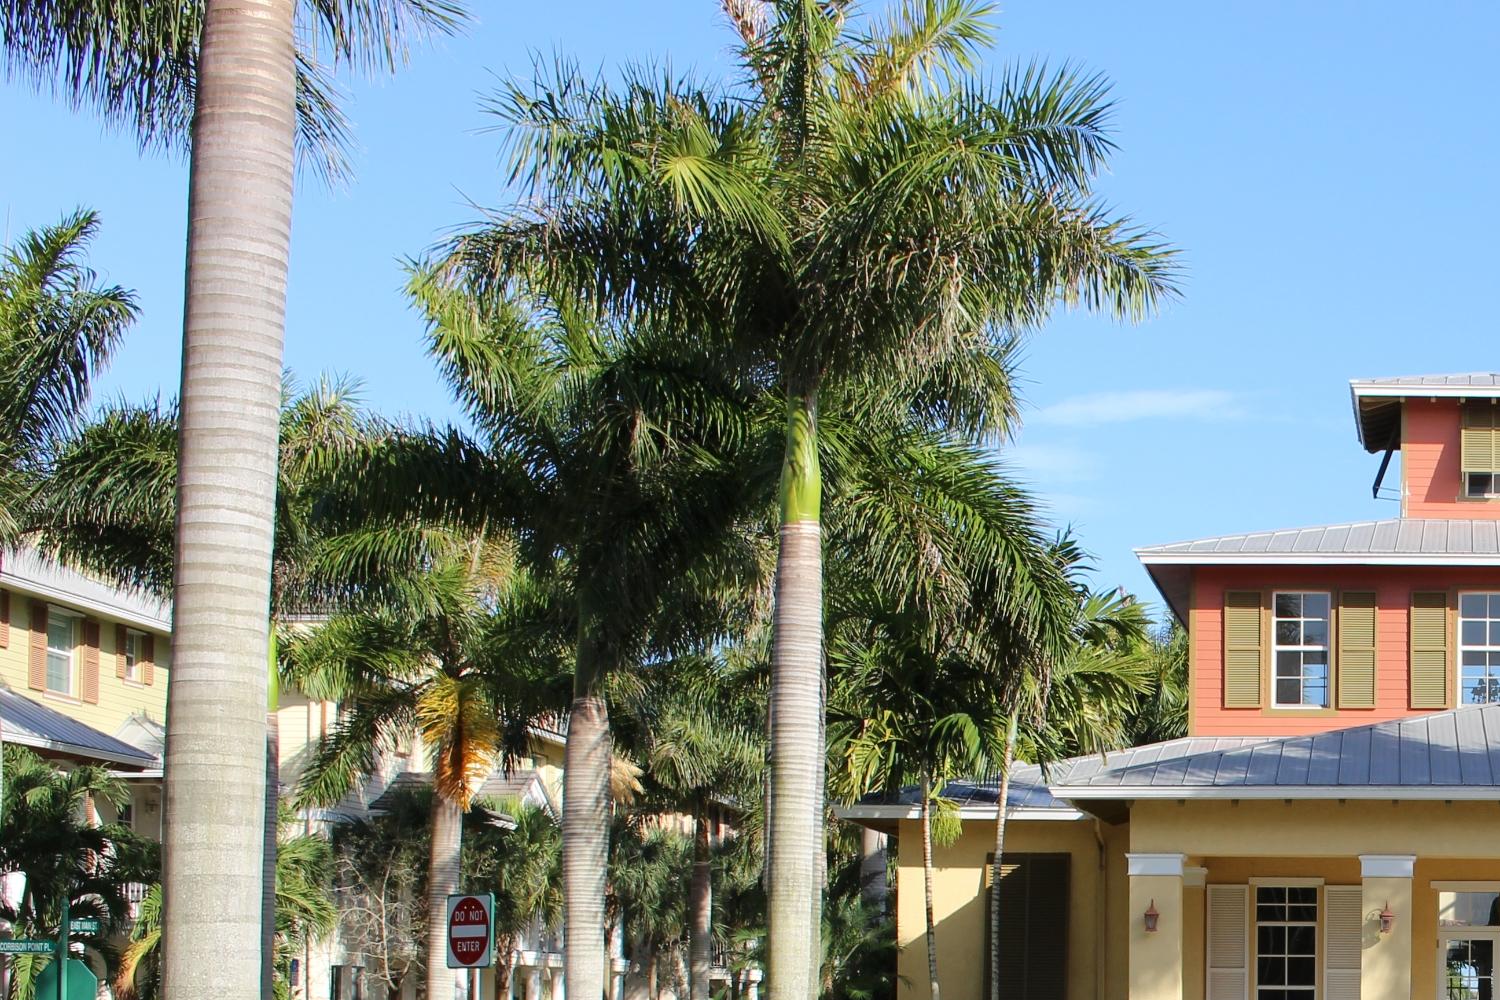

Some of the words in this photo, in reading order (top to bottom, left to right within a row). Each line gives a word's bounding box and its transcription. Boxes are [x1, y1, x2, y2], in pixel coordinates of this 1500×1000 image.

[455, 911, 465, 921] DO
[469, 910, 484, 921] NOT
[28, 942, 43, 951] POINT
[457, 941, 480, 952] ENTER
